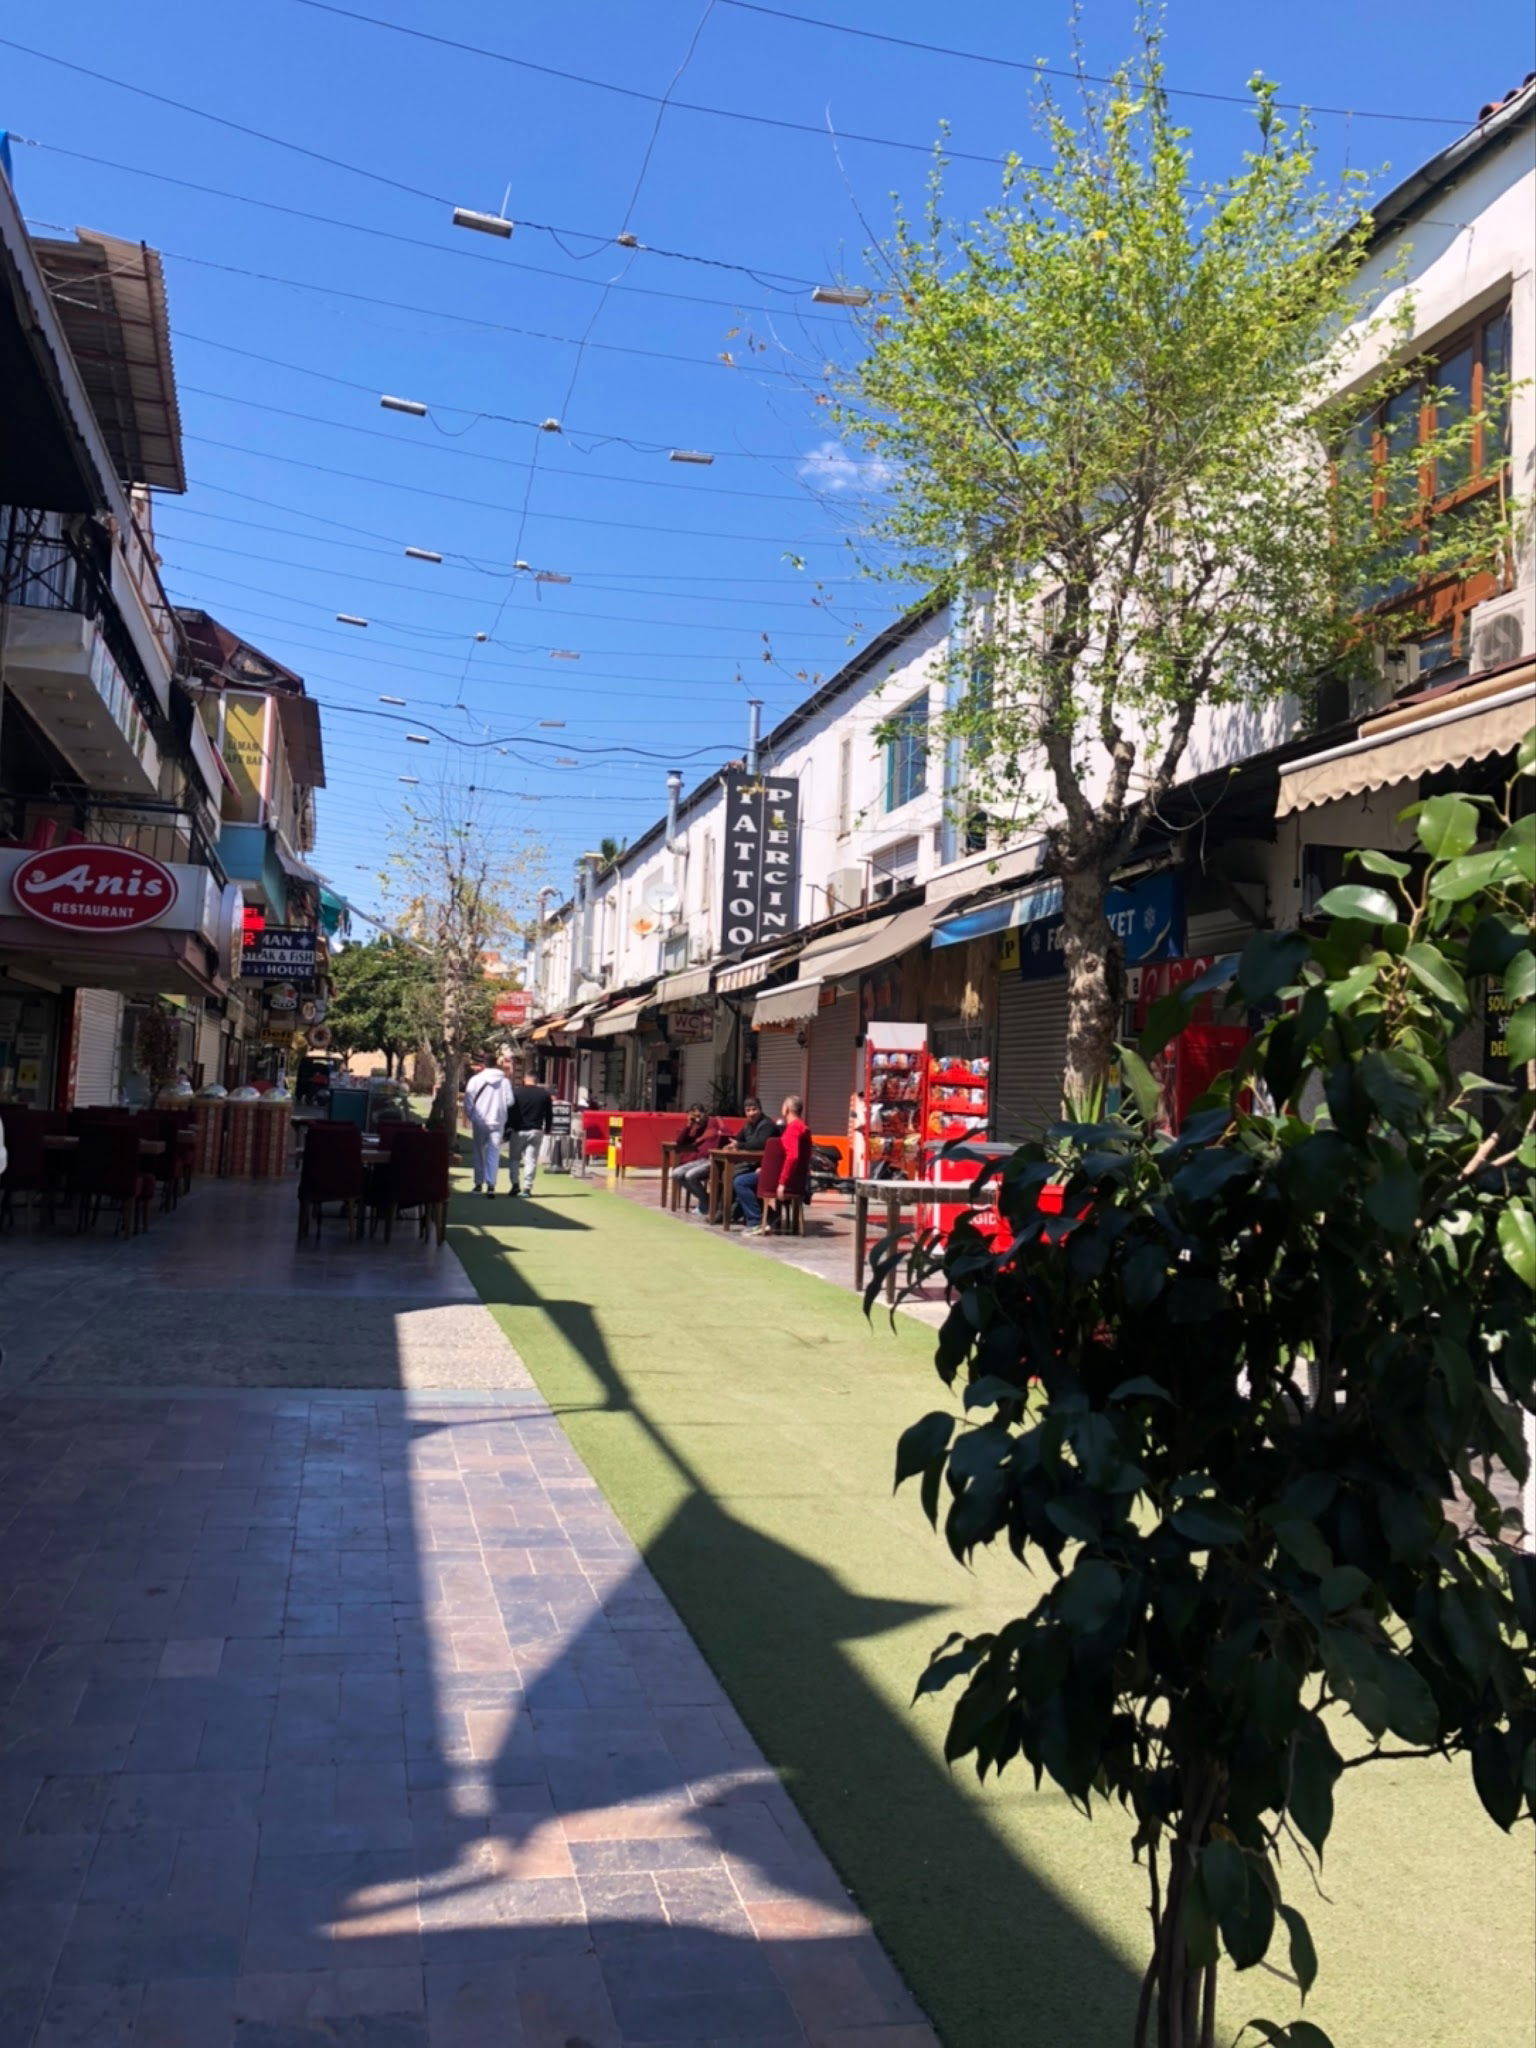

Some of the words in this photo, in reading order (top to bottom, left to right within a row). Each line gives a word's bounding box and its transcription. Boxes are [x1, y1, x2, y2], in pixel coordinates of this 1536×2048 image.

[727, 785, 757, 945] TATTOO
[24, 864, 162, 896] Anis
[52, 902, 135, 918] RESTAURANT
[267, 965, 313, 976] HOUSE
[674, 1015, 700, 1029] WC
